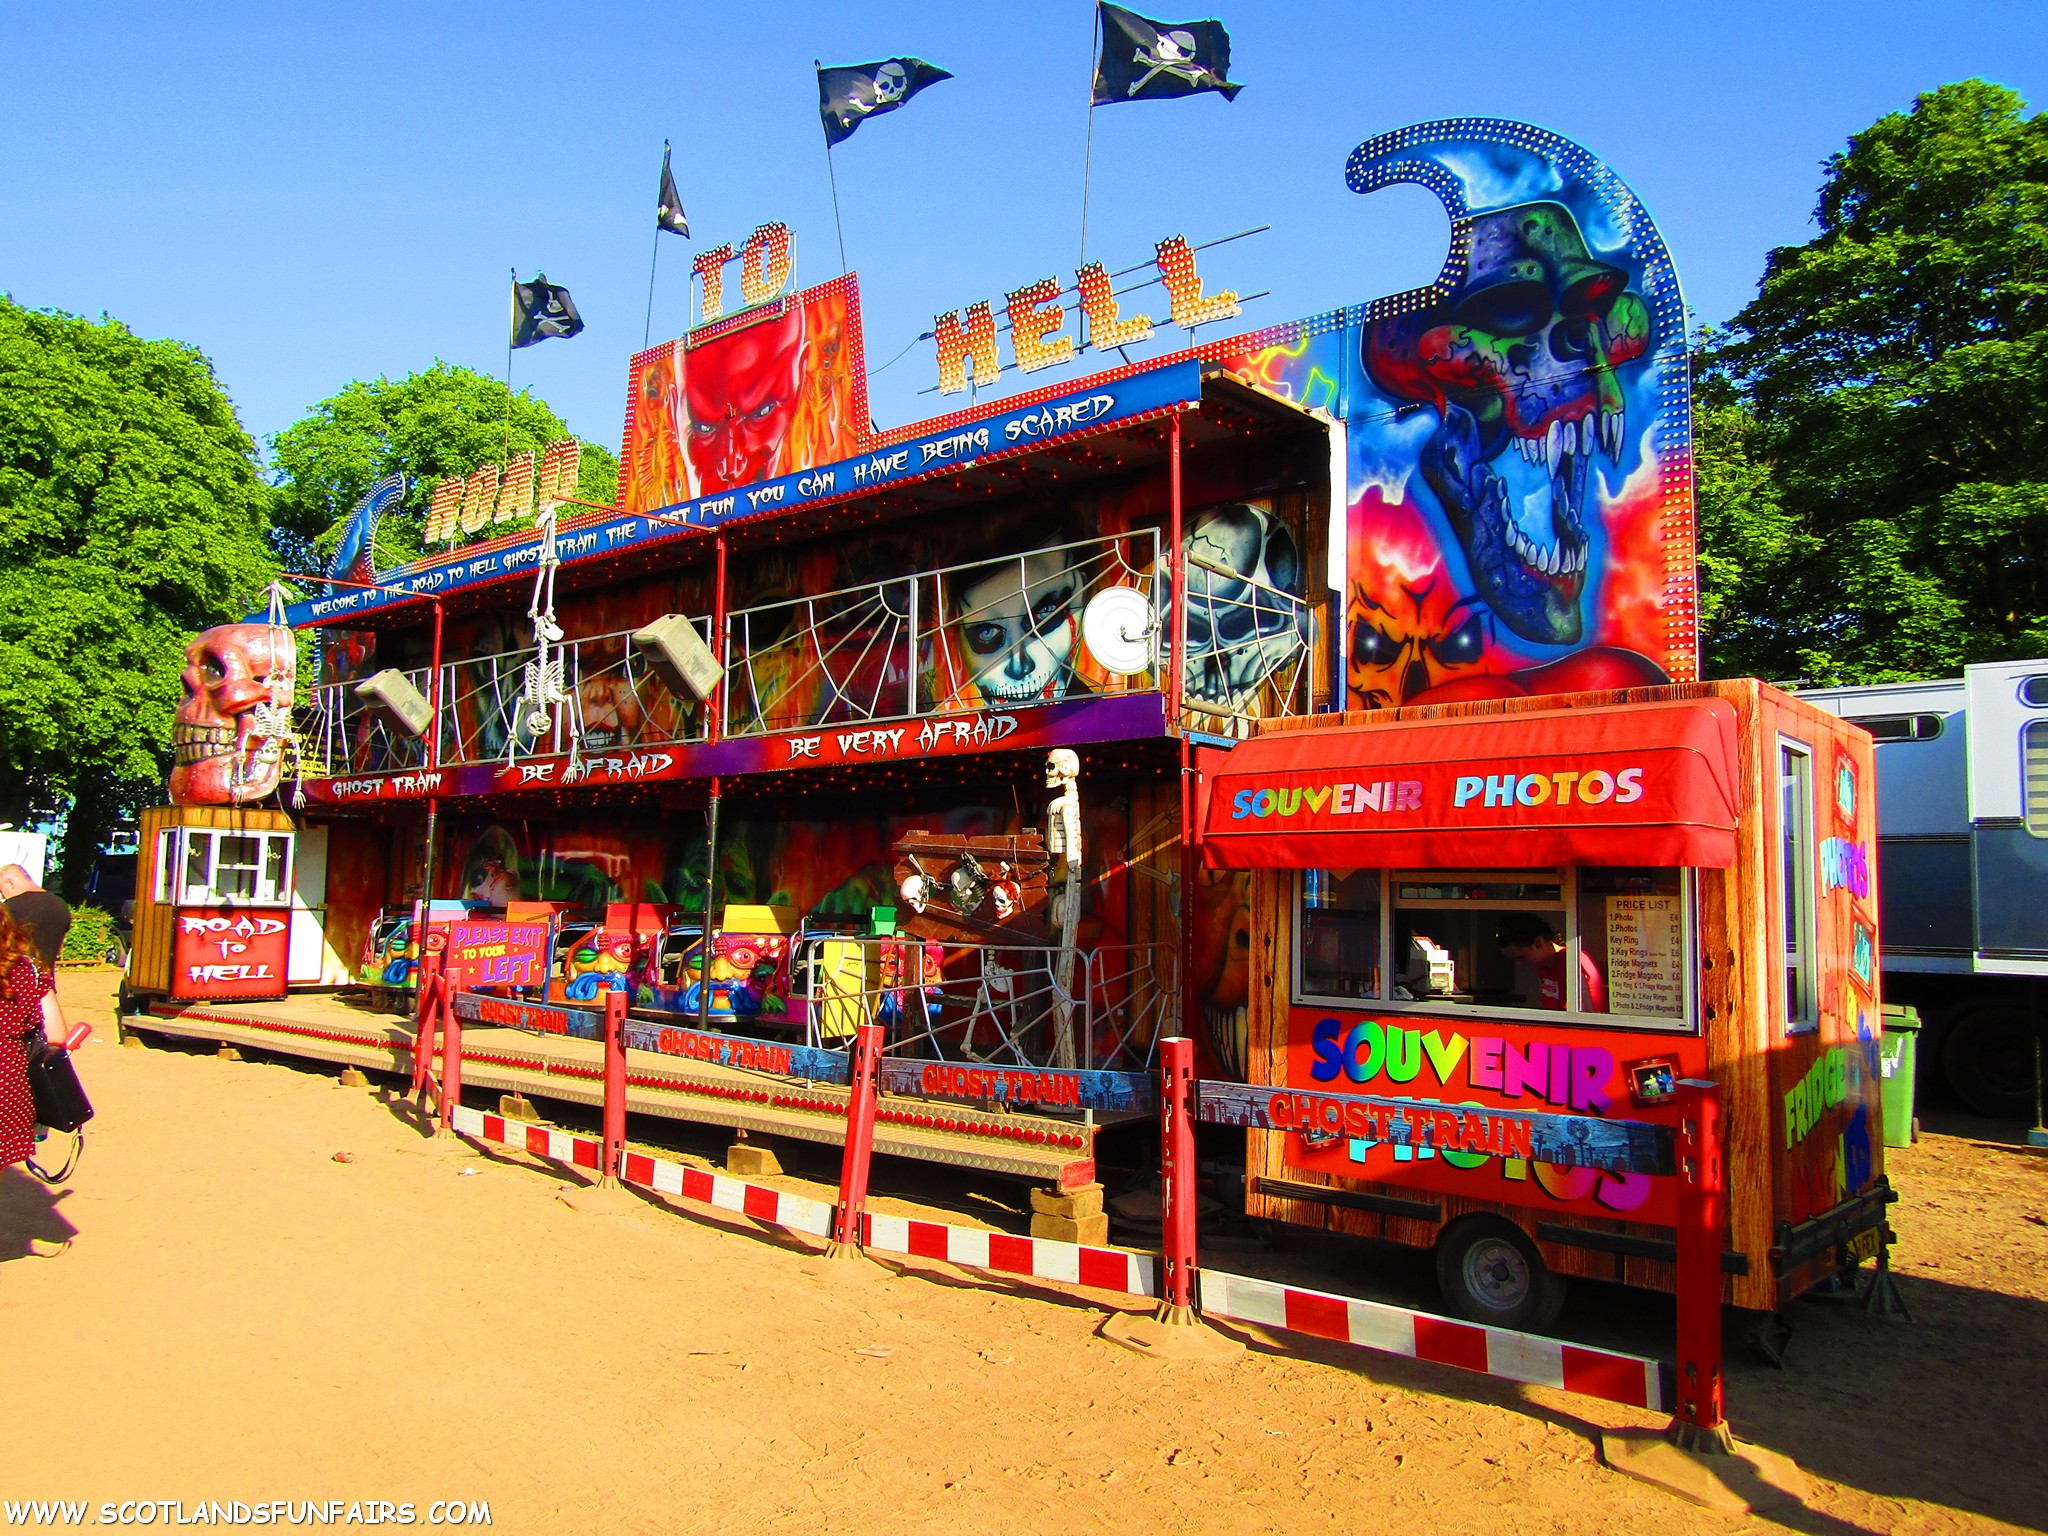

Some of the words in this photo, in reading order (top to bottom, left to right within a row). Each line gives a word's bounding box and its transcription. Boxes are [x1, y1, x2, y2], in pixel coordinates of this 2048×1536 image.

[693, 220, 792, 323] TO
[933, 233, 1242, 396] HELL
[311, 593, 359, 616] WELCOME
[362, 589, 376, 606] TO
[411, 571, 444, 593] ROAD
[447, 566, 464, 585] TO
[469, 557, 498, 578] HELL
[503, 544, 547, 571] GHOST
[556, 532, 597, 558] TRAIN
[606, 522, 637, 546] THE
[648, 507, 692, 534] MOST
[699, 496, 735, 522] FUN
[747, 487, 785, 510] YOU
[797, 471, 835, 498] CAN
[853, 452, 910, 485] HAVE
[918, 428, 990, 466] BEING
[1004, 395, 1115, 442] SCARED
[424, 437, 580, 544] ROAD
[786, 736, 821, 762] BE
[837, 728, 905, 756] VERY
[914, 713, 1018, 753] AFRAID
[332, 778, 384, 799] GHOST
[392, 771, 442, 796] TRAIN
[517, 763, 555, 785] BE
[575, 752, 673, 783] AFRAID
[1232, 780, 1425, 820] SOUVENIR
[1454, 768, 1643, 808] PHOTOS
[1819, 836, 1869, 901] PHOTOS
[1616, 901, 1645, 909] PRICE
[1648, 901, 1670, 909] LIST
[180, 915, 287, 939] ROAD
[455, 927, 509, 948] PLEASE
[512, 927, 543, 948] EXIT
[1610, 924, 1638, 932] 2.Photos
[1610, 936, 1622, 945] Key
[1624, 936, 1639, 945] Ring
[462, 949, 477, 960] TO
[479, 944, 506, 958] YOUR
[483, 953, 537, 983] LEFT
[1611, 948, 1628, 957] 2.Key
[1629, 948, 1648, 958] Rings
[1611, 959, 1630, 968] Fridge
[1631, 959, 1658, 969] Magnets
[1637, 971, 1663, 981] Magnets
[480, 1000, 523, 1026] GHOST
[525, 1007, 568, 1035] TRAIN
[658, 1028, 725, 1061] GHOST
[728, 1041, 791, 1074] TRAIN
[1310, 1018, 1615, 1114] SOUVENIR
[922, 1065, 999, 1098] GHOST
[1003, 1071, 1079, 1105] TRAIN
[1784, 1047, 1846, 1150] FRIDGE
[1267, 1092, 1395, 1139] GHOST
[1402, 1107, 1533, 1157] TRAIN
